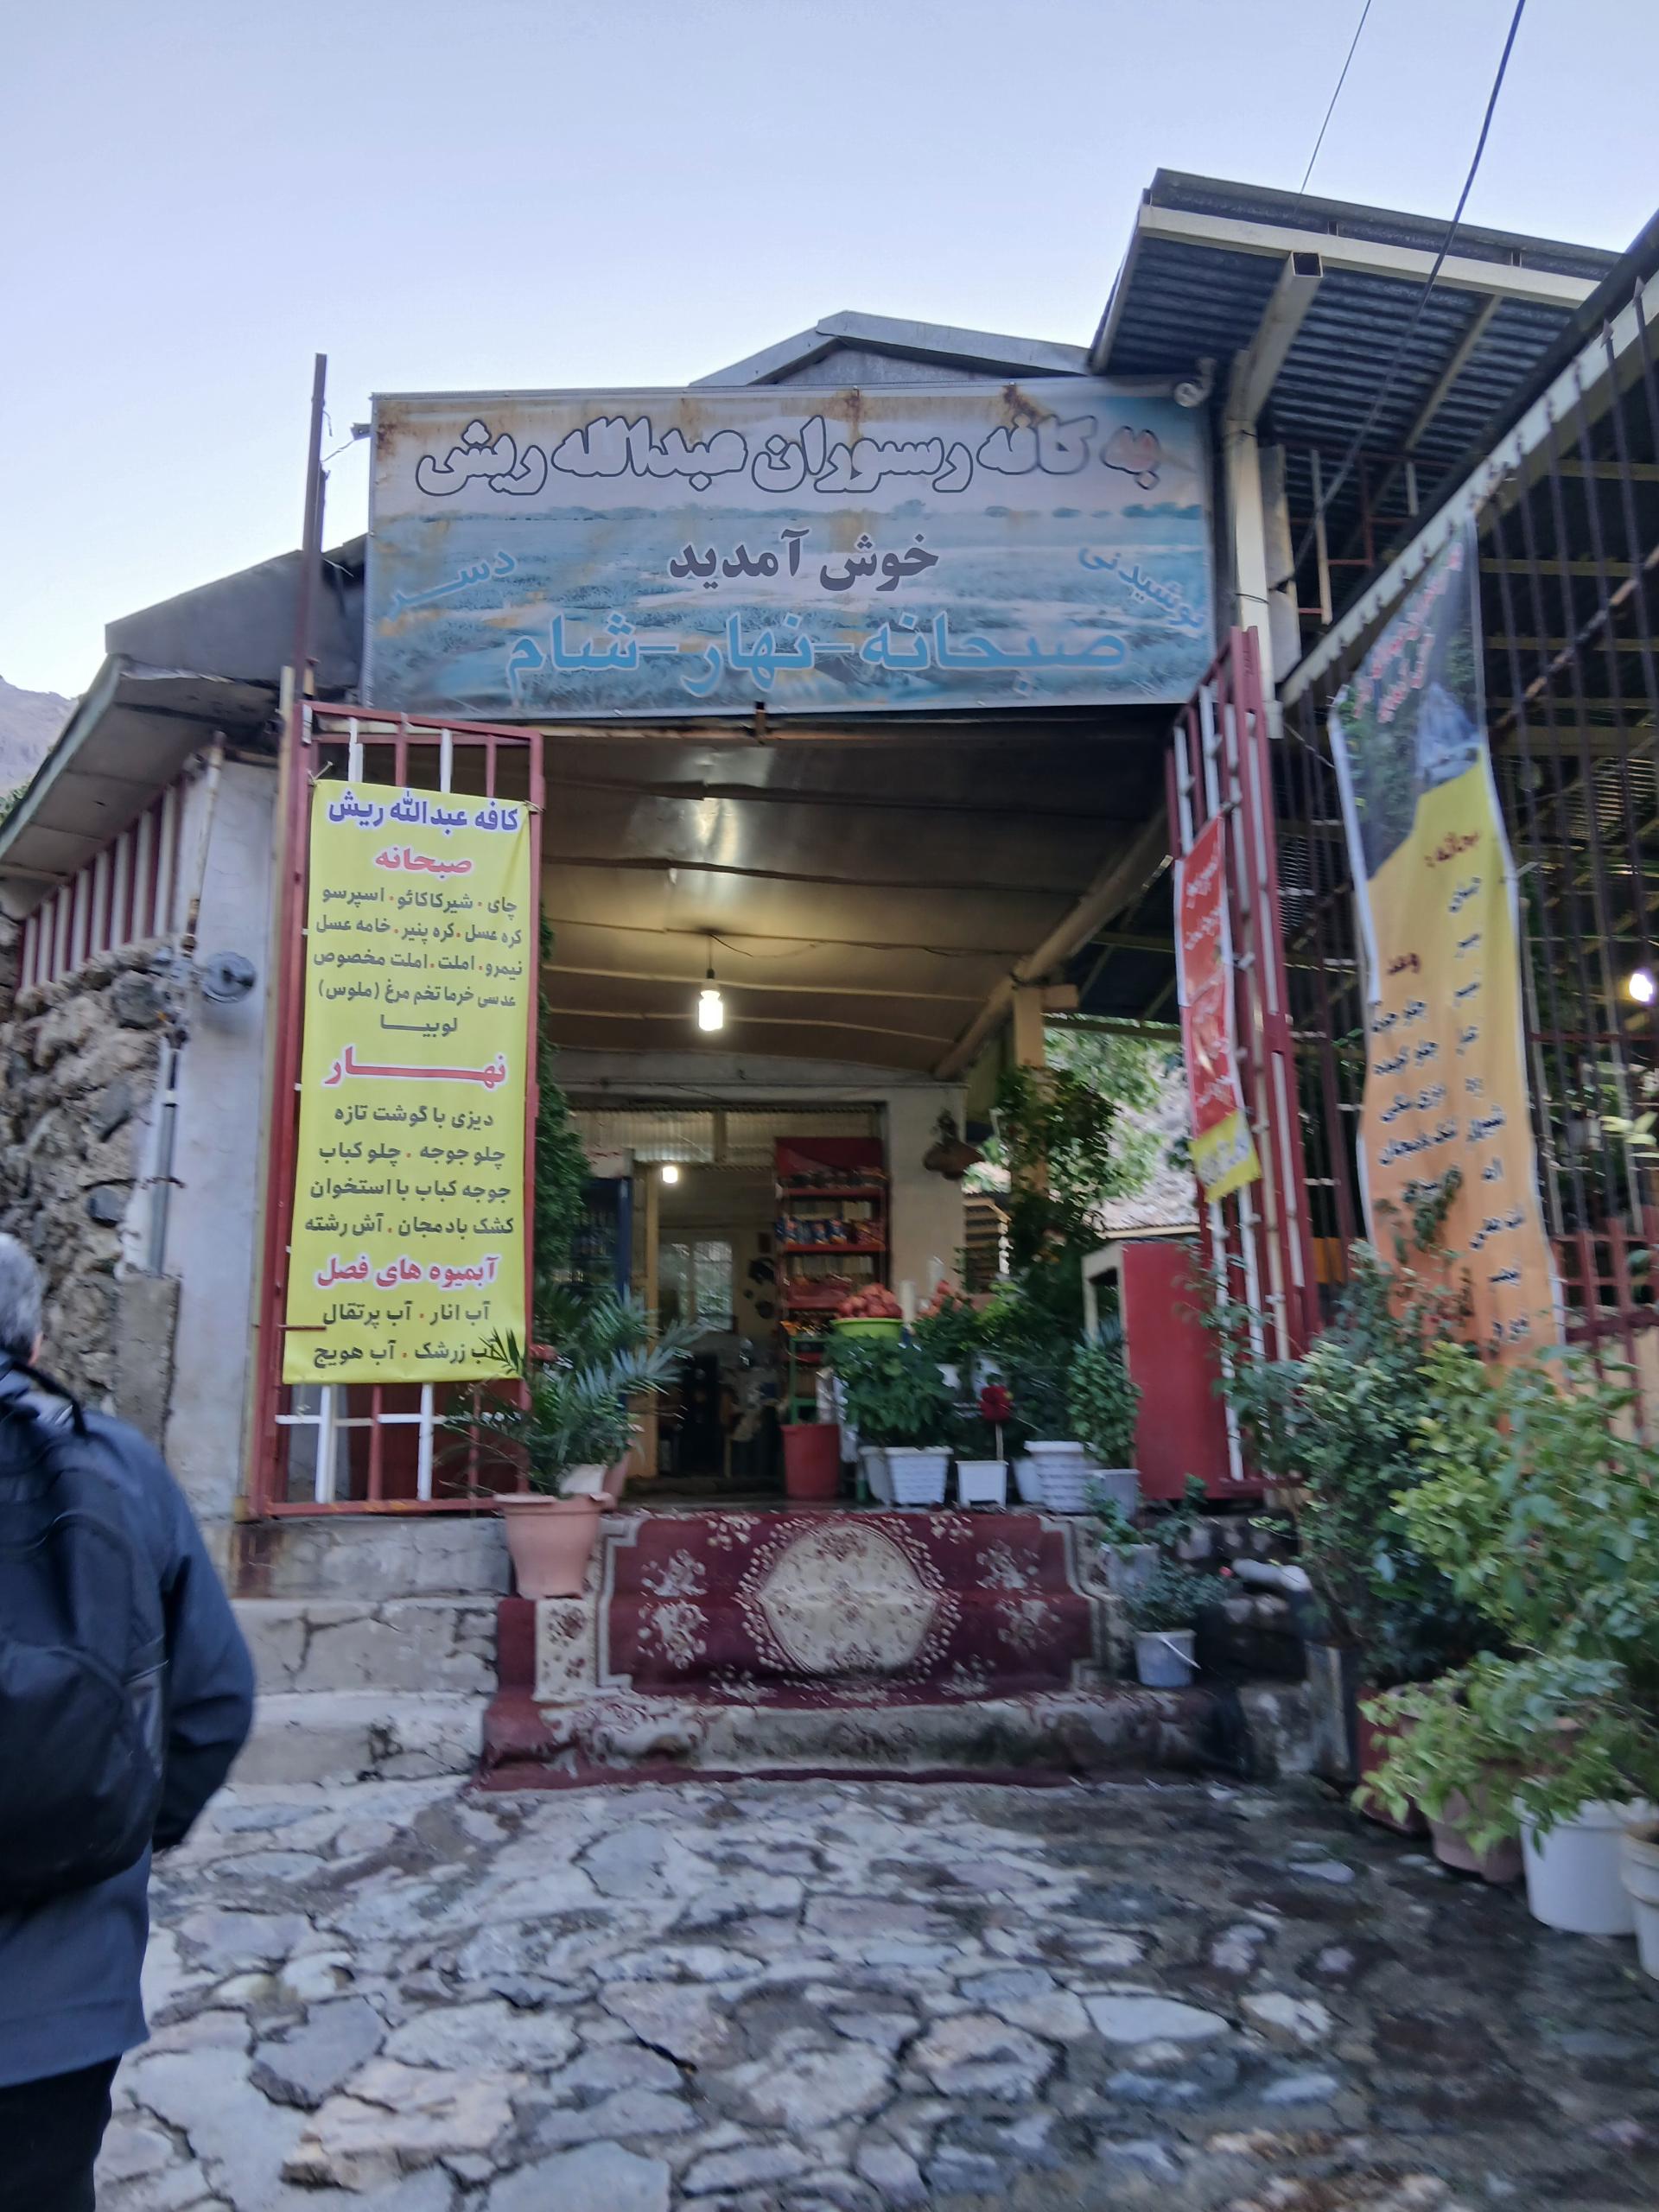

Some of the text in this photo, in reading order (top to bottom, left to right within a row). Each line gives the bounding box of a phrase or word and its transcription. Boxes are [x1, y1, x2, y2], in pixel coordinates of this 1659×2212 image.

[976, 413, 1097, 474] کافه
[415, 420, 548, 496] ریش
[669, 529, 939, 592] خوش آمدید
[328, 791, 384, 827] ریش
[475, 801, 518, 830] کافه
[375, 847, 472, 879] صبحانه
[322, 887, 385, 908] اسپرسو
[487, 897, 517, 919] چای
[316, 914, 522, 948] کره عسل کره پنیر خامه عسل
[314, 949, 522, 981] نیمرو املت املت مخصوص
[385, 979, 410, 1004] مرغ
[477, 994, 516, 1007] عدسی
[334, 1104, 493, 1129] دیزی با گوشت تازه
[319, 1142, 505, 1169] چلو جوجه چلو کباب
[310, 1178, 511, 1203] جوجه کباب با استخوان
[305, 1212, 513, 1240] کشک بادمجان آش رشته
[317, 1255, 498, 1287] آبمیوه های فصل
[322, 1301, 491, 1328] آب انار آب پرتقال
[313, 1345, 363, 1369] هویج
[370, 1340, 396, 1362] آب
[414, 1341, 466, 1363] زرشک
